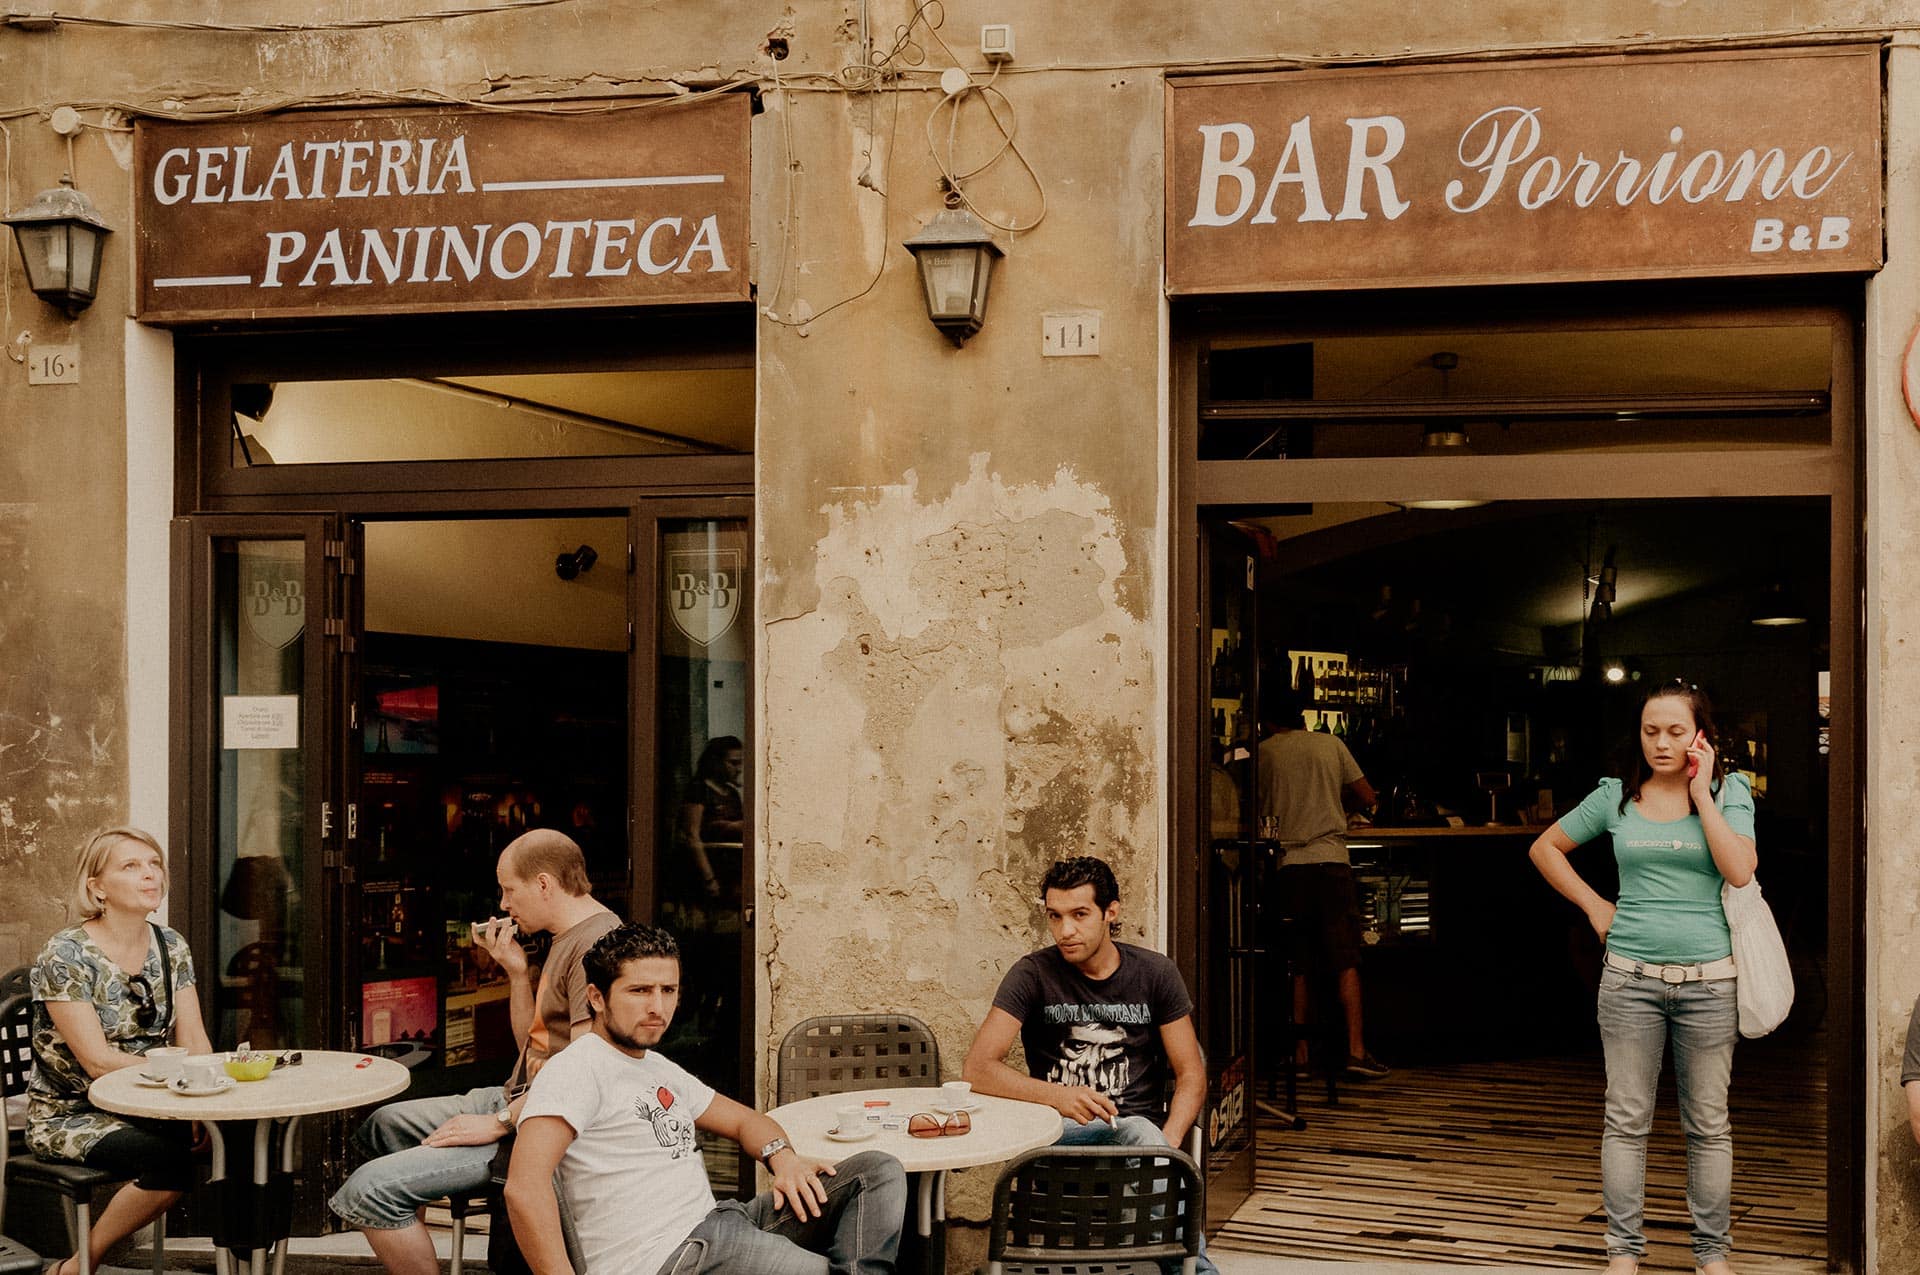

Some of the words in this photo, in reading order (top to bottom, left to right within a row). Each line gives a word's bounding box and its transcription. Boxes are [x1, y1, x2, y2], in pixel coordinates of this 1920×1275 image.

[154, 134, 475, 205] GELATERIA
[1188, 115, 1411, 227] BAR
[1445, 106, 1853, 214] Porrione
[259, 214, 731, 288] PANINOTECA
[1749, 216, 1850, 253] B&B
[42, 354, 65, 378] 16
[1081, 1003, 1152, 1025] MONTANA
